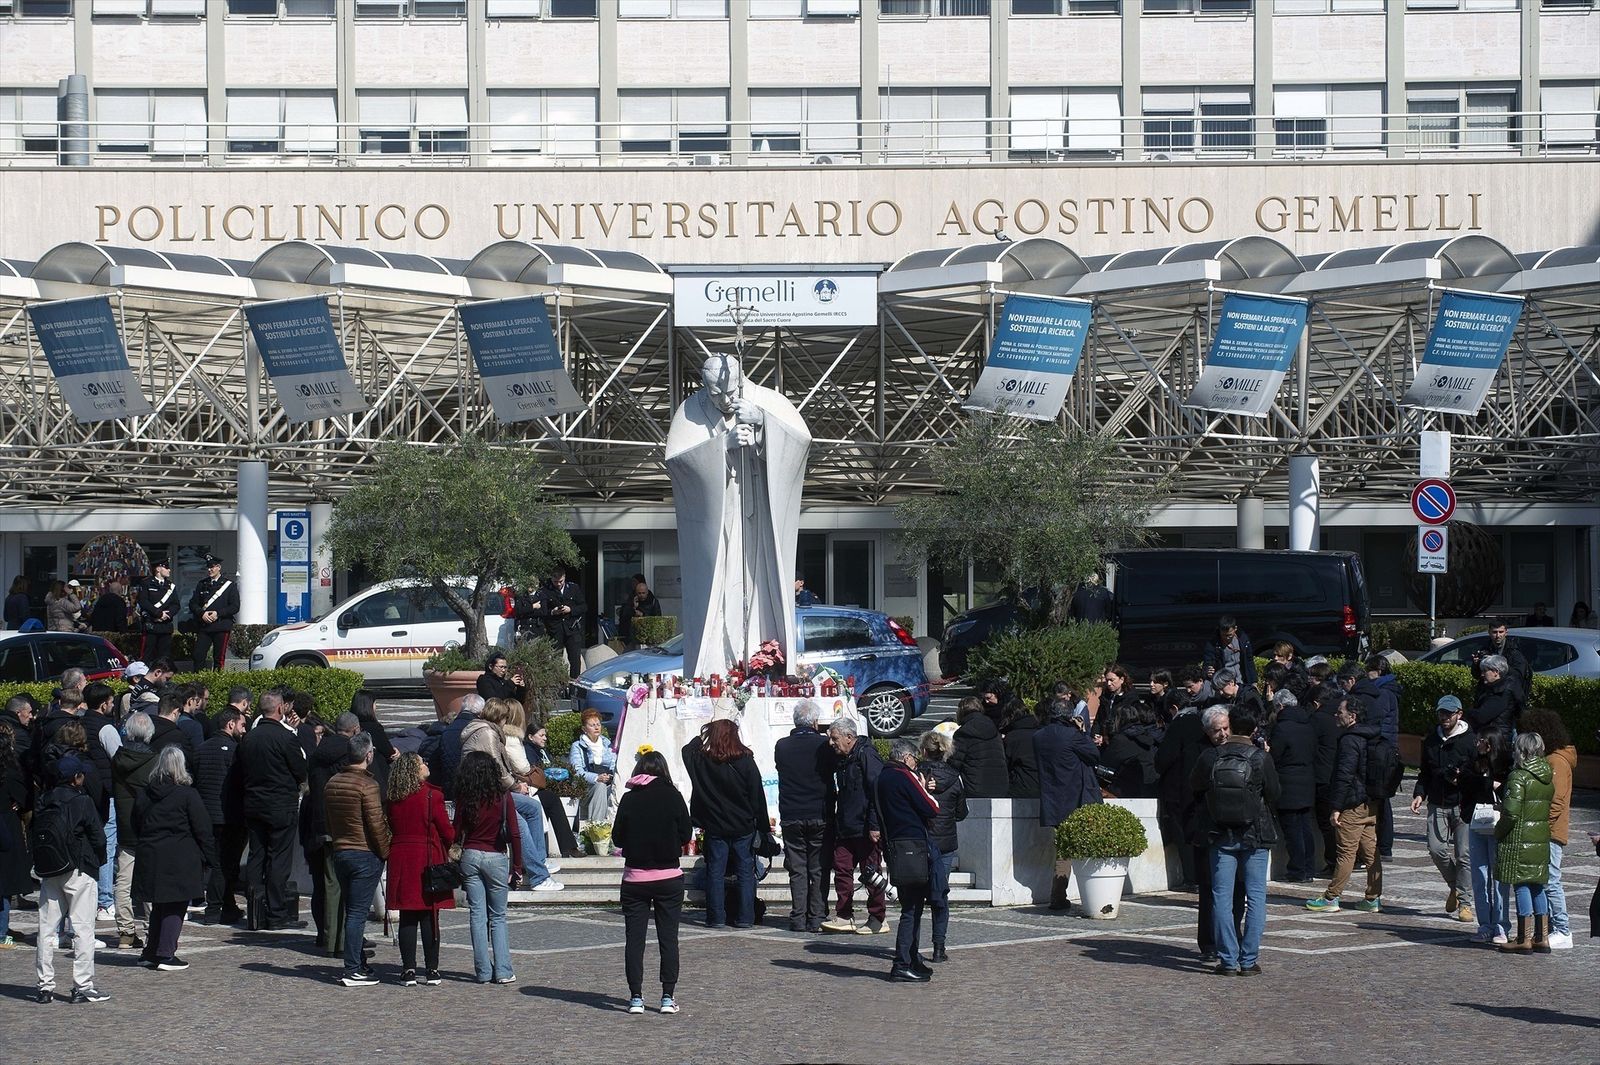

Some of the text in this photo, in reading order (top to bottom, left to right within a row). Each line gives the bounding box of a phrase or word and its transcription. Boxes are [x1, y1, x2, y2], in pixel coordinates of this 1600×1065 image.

[95, 194, 1482, 242] POLICLINICO UNIVERSITARIO AGOSTINO GEMELLI
[704, 280, 795, 302] Gemelli
[1227, 311, 1240, 319] NON
[1240, 313, 1263, 321] FERMARE
[1443, 309, 1459, 318] NON
[1459, 311, 1486, 320] FERMARE
[258, 323, 273, 331] NON
[273, 320, 300, 329] FERMARE
[300, 318, 308, 326] LA
[484, 320, 507, 329] FERMARE
[1008, 313, 1082, 328] NON FERMARE LA CURA,
[1233, 322, 1256, 330] SOSTIENI
[1444, 320, 1472, 329] SOSTIENI
[265, 330, 291, 340] SOSTIENI
[291, 329, 300, 337] LA
[482, 330, 505, 339] SOSTIENI
[1010, 323, 1039, 333] SOSTIENI
[1048, 327, 1076, 337] RICERCA.
[291, 525, 297, 535] E
[337, 647, 439, 660] URBE VIGILANZA
[107, 657, 120, 668] 112
